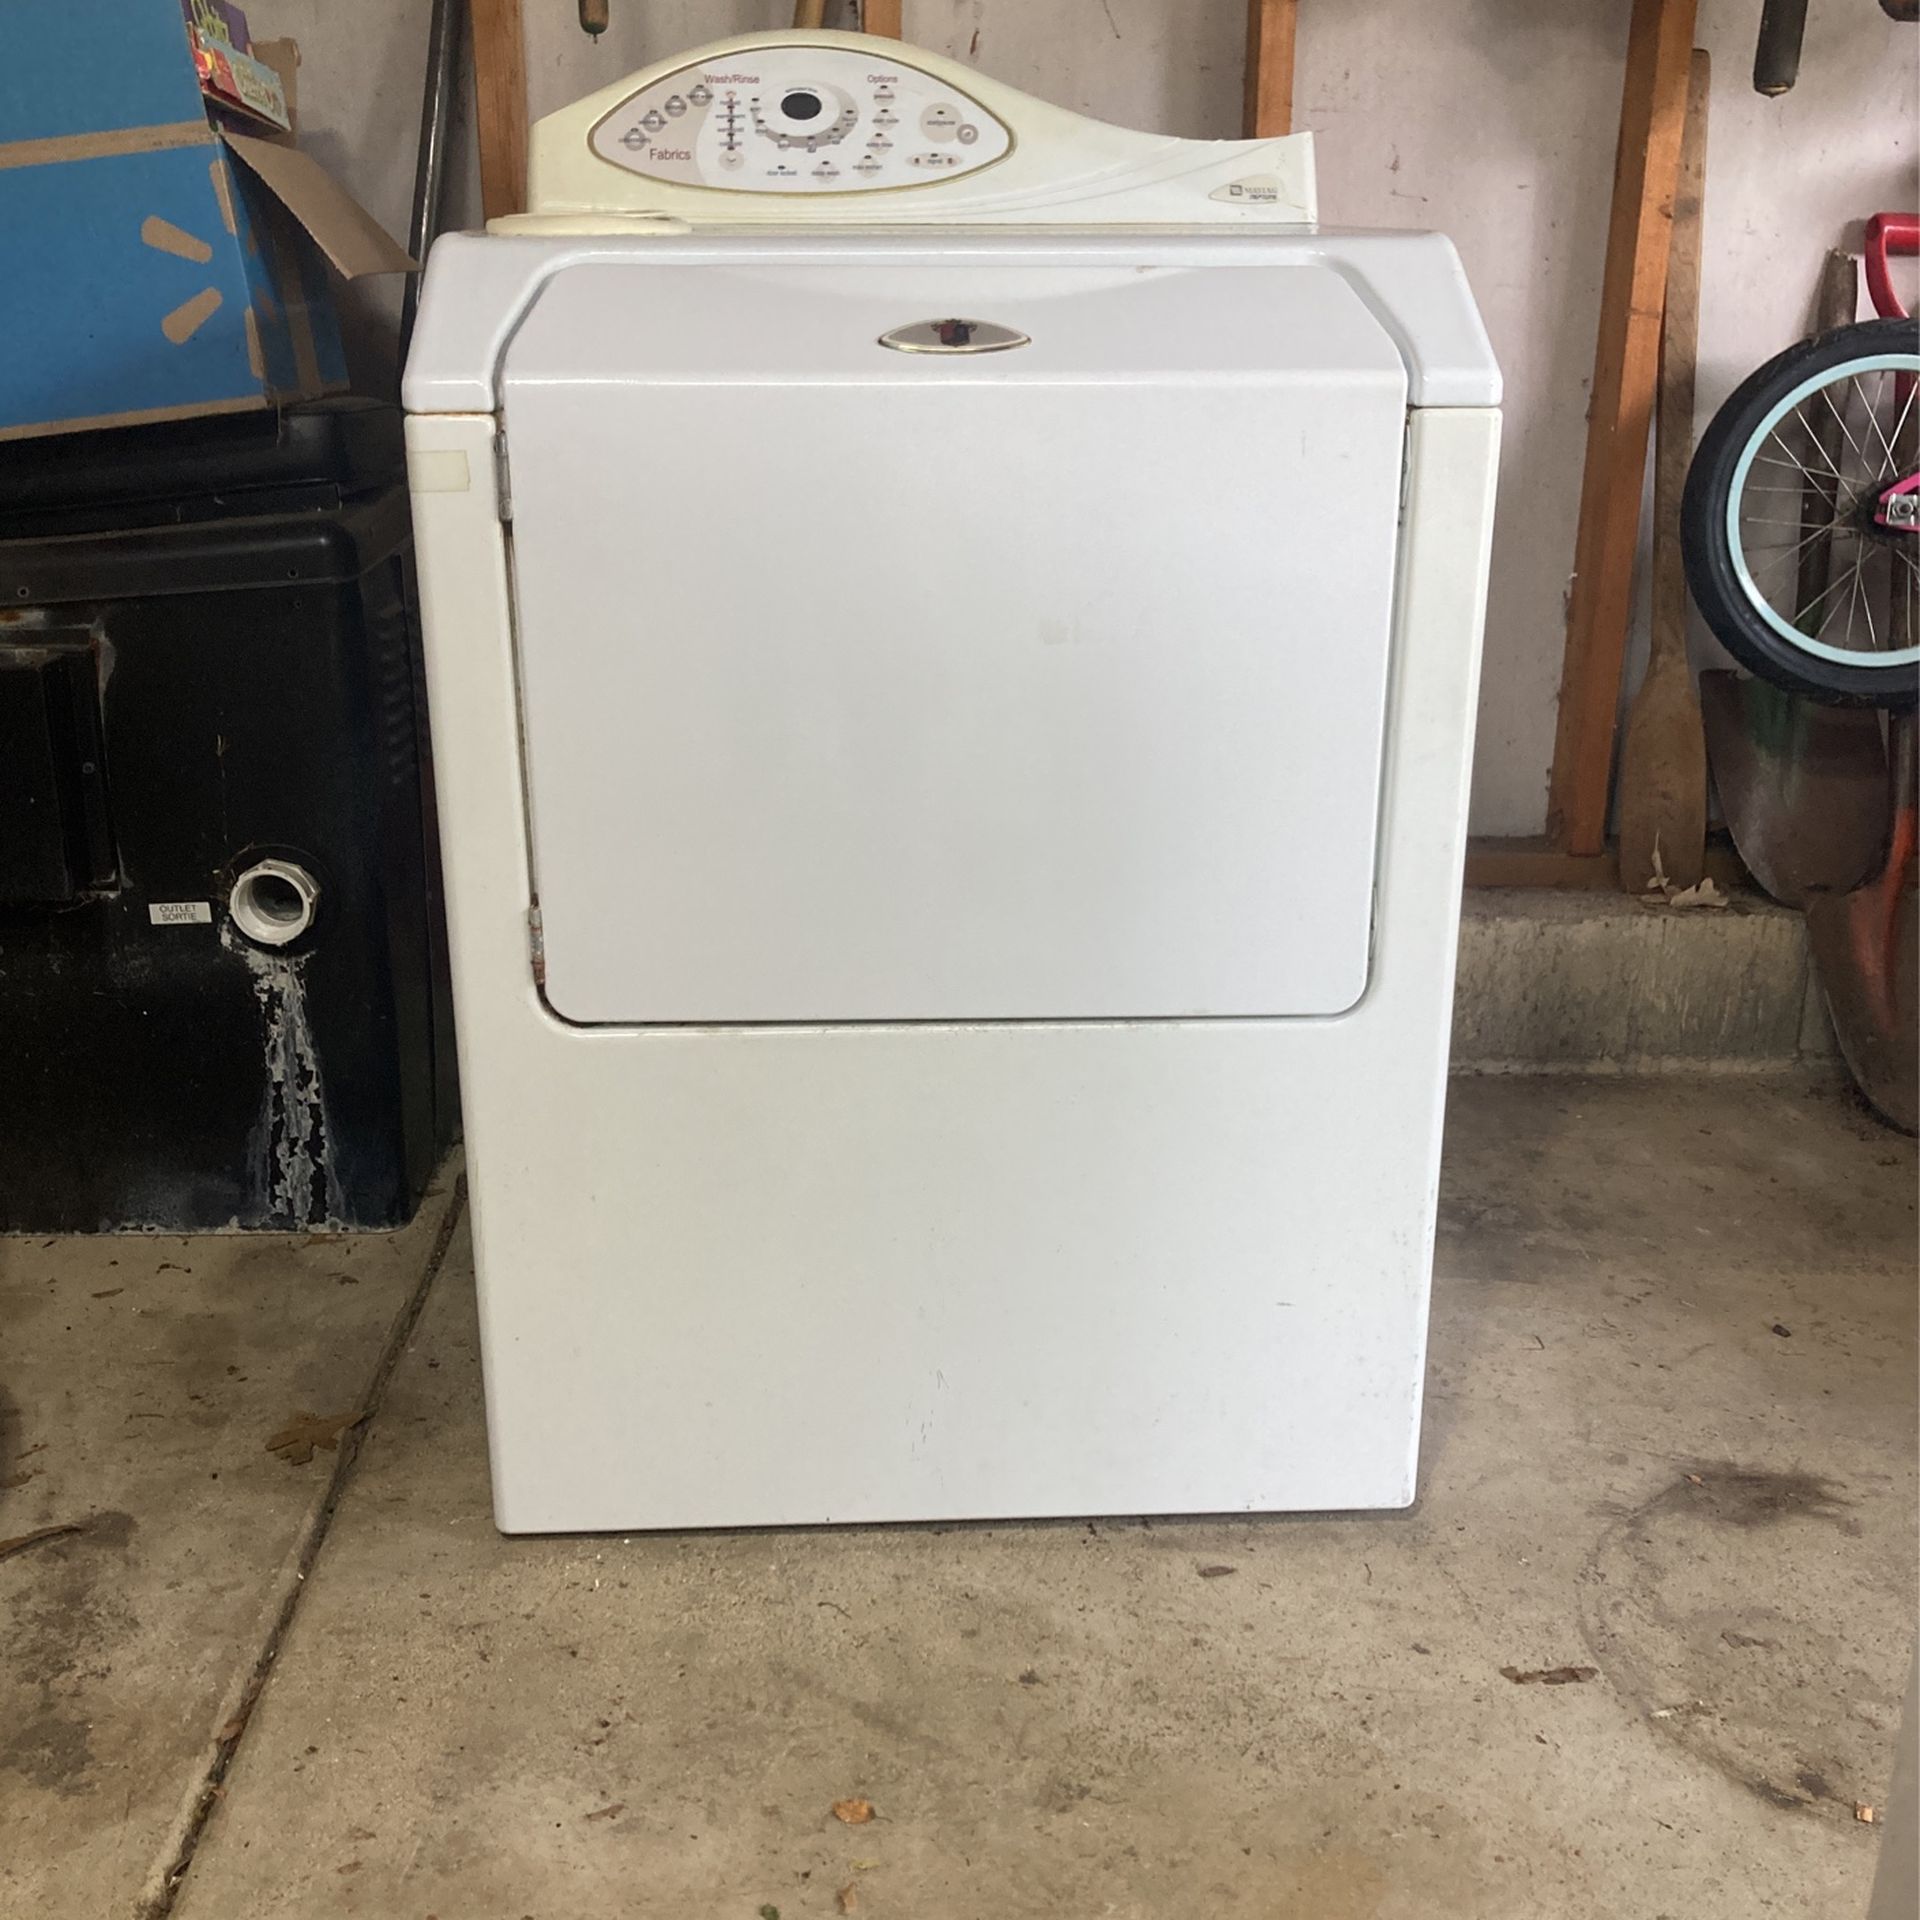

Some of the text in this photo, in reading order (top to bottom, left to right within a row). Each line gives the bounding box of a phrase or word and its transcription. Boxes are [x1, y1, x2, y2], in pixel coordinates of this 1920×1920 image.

[704, 74, 760, 84] Wash/Rinse
[867, 74, 898, 84] Options
[649, 148, 692, 161] Fabrics
[159, 904, 196, 913] OUTLET
[161, 912, 197, 921] SORTIE
